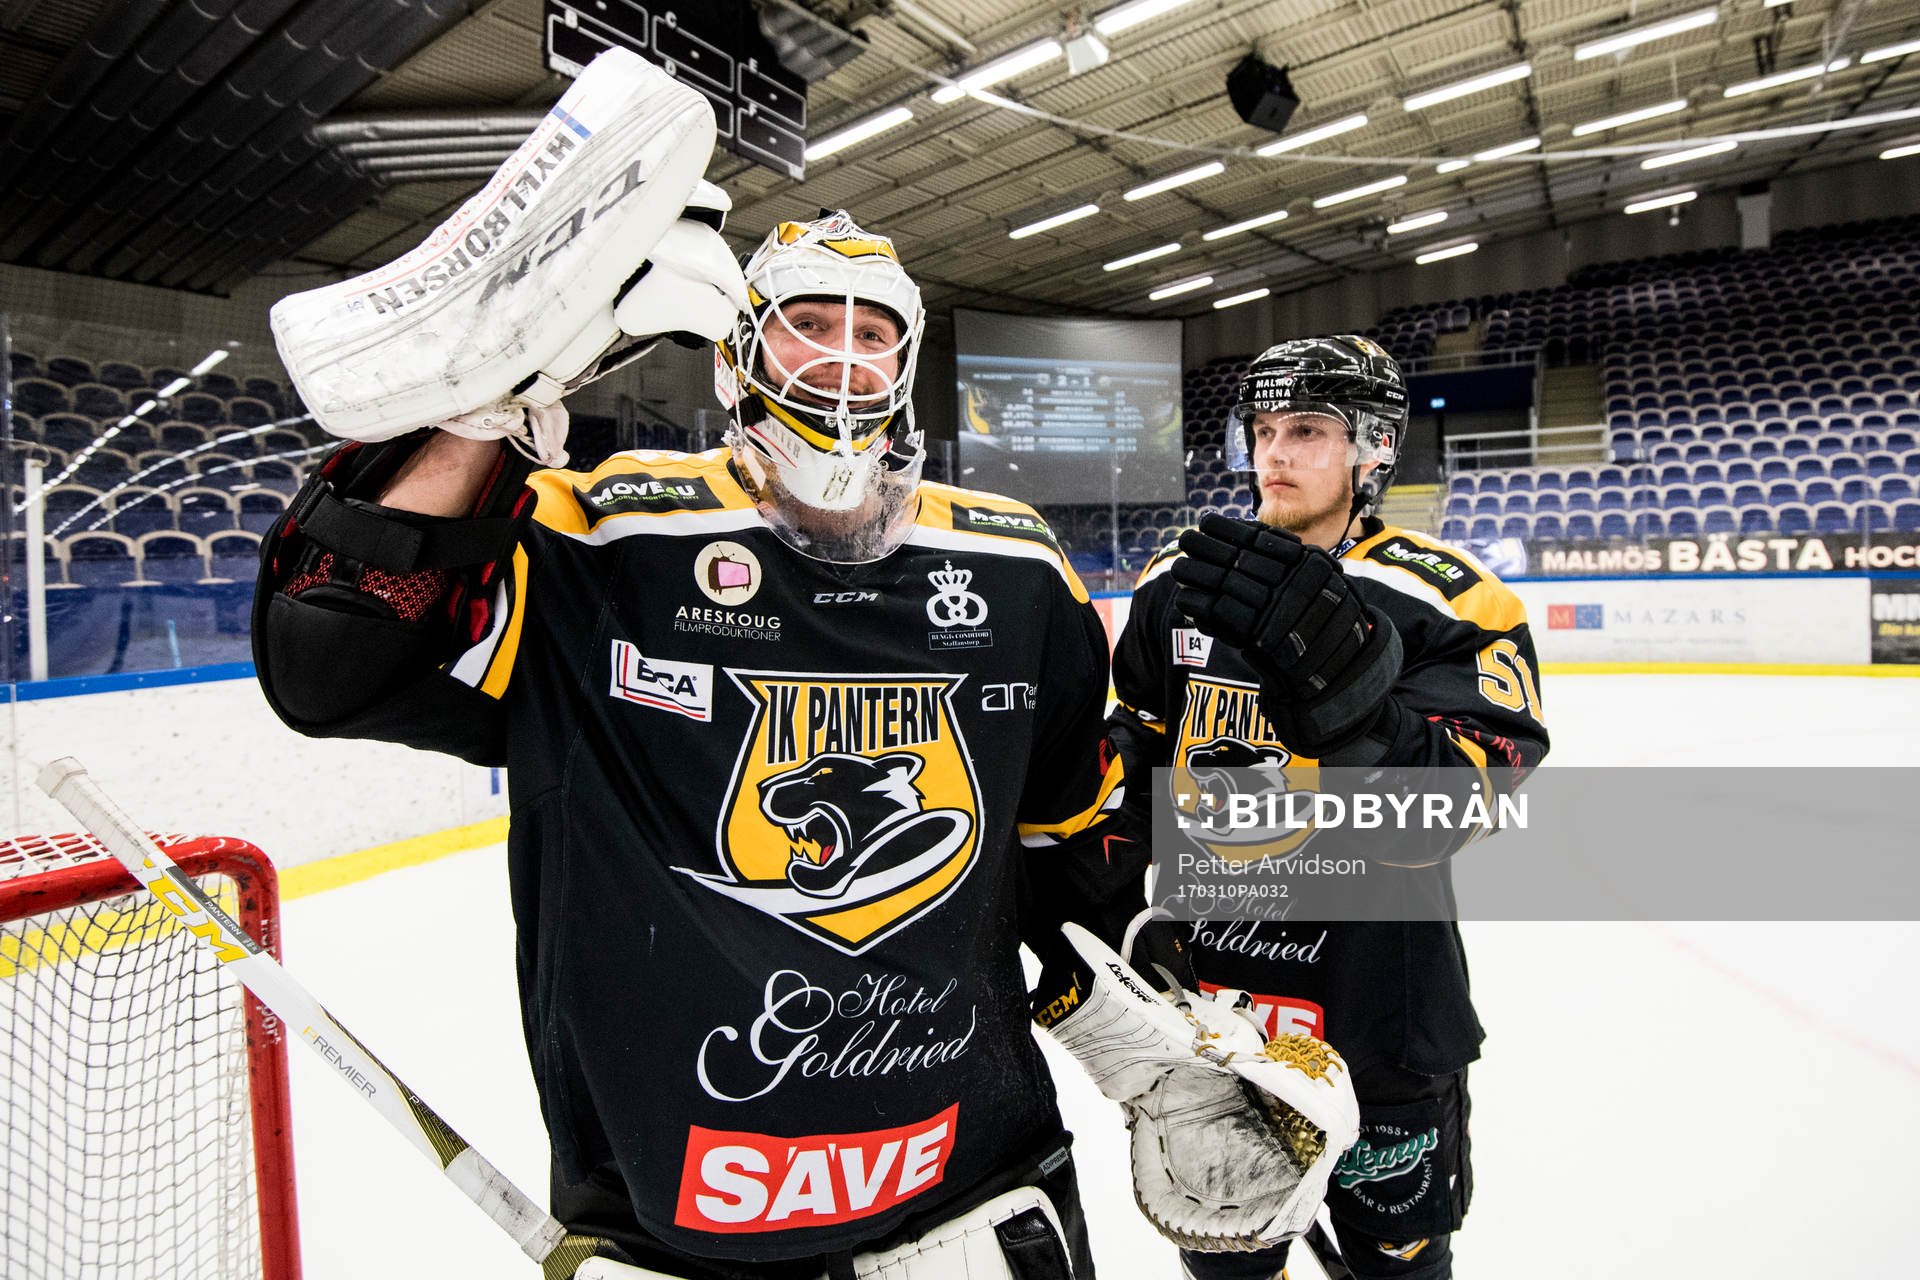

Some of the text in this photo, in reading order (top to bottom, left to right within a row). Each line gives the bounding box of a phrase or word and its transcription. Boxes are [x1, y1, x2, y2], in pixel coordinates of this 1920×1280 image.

[665, 11, 677, 29] C
[1255, 389, 1292, 399] ARENA
[1386, 391, 1405, 401] CCM
[591, 481, 696, 505] MOVE4U
[1541, 534, 1920, 571] MALMÖS BÄSTA HOC
[813, 591, 879, 604] CCM
[674, 620, 782, 642] FILMPRODUKTIONER
[675, 606, 782, 630] ARESKOUG
[1613, 608, 1747, 625] MAZARS
[1476, 638, 1547, 726] 51
[764, 684, 946, 766] IK PANTERN
[1190, 684, 1213, 739] IK
[143, 858, 250, 964] CM
[204, 900, 243, 936] PANTERN
[837, 972, 958, 1020] Hotel
[1035, 984, 1080, 1027] CCM
[697, 969, 977, 1102] Goldried
[303, 1025, 377, 1099] PREMIER
[1353, 1187, 1375, 1208] BAR
[1389, 1156, 1433, 1215] RESTAURANT
